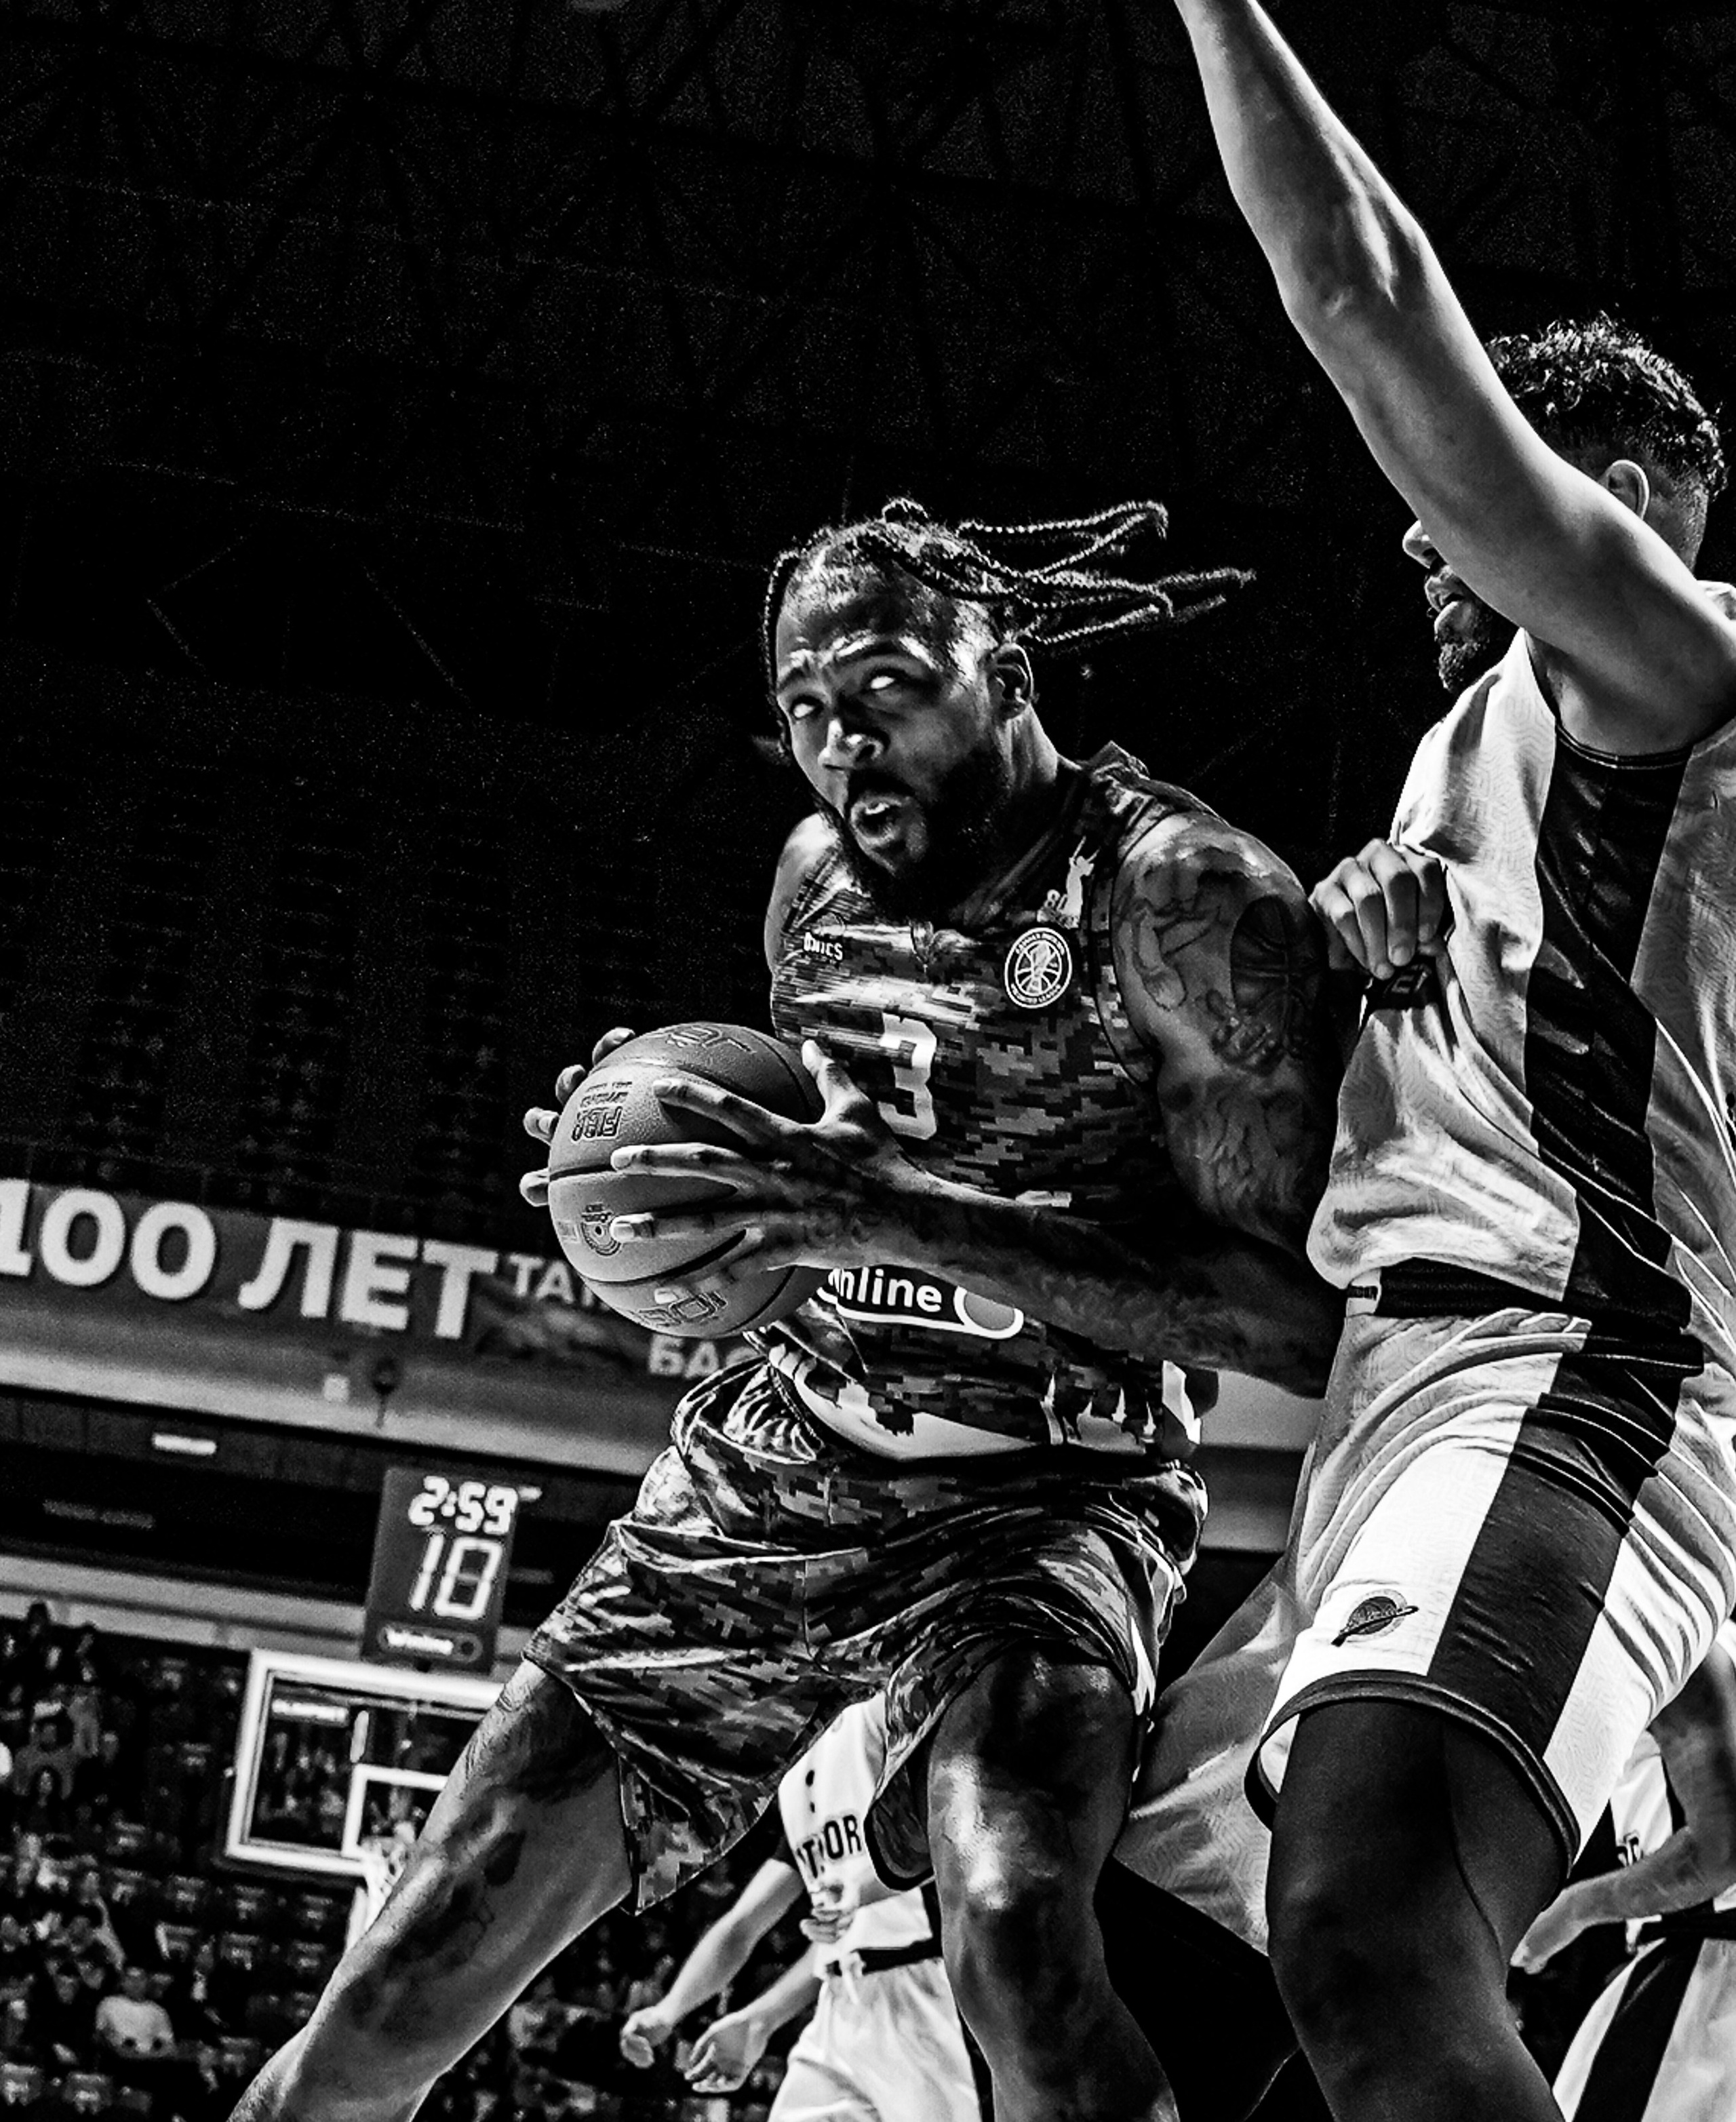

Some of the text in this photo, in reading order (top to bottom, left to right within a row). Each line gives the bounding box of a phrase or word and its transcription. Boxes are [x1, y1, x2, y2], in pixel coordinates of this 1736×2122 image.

[878, 1013, 937, 1140] 3
[0, 1178, 217, 1301] 100
[238, 1217, 498, 1339] ЛЕТ
[408, 1476, 519, 1535] 2:59
[410, 1534, 502, 1620] 10
